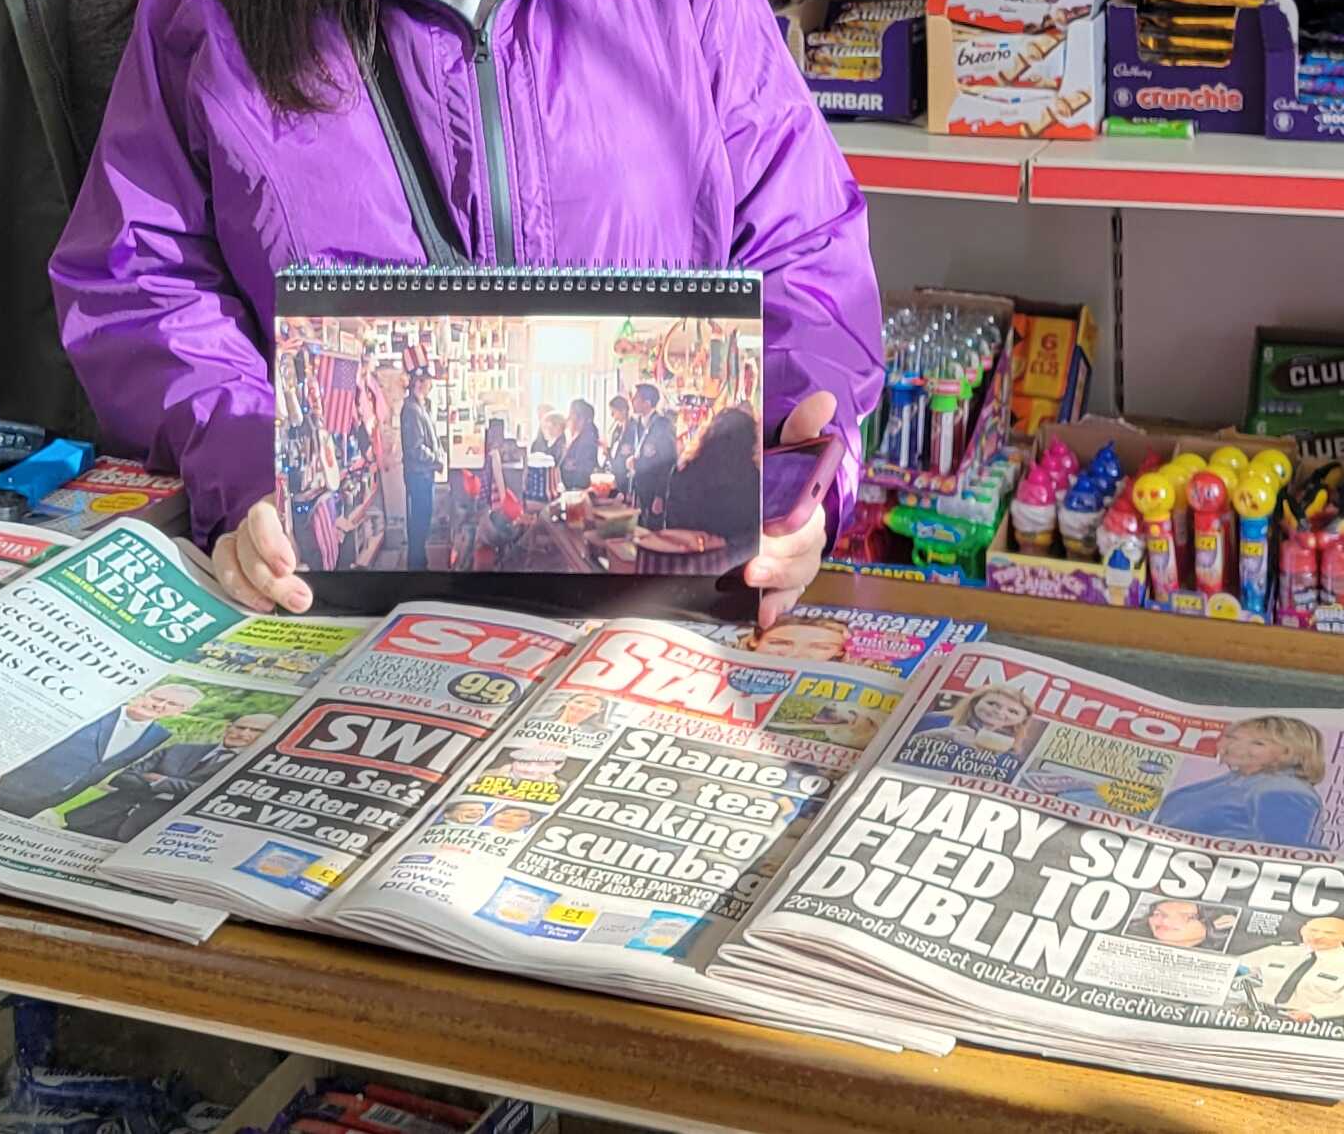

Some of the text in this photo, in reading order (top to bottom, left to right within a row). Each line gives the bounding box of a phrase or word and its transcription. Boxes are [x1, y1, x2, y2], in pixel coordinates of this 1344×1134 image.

[957, 46, 1012, 67] bueno
[1136, 83, 1243, 112] crunchie
[118, 531, 166, 571] THE
[66, 554, 194, 645] NEWS
[92, 541, 216, 634] IRISH
[12, 585, 151, 677] Criticism as
[667, 644, 736, 674] DAILY
[24, 665, 83, 702] LCC
[78, 649, 140, 689] DUP
[797, 676, 856, 702] FAT
[962, 656, 1222, 755] Mirror
[251, 752, 427, 807] Home Sec's
[616, 728, 789, 788] Shame
[226, 776, 365, 821] gig after
[593, 761, 781, 821] the tea
[861, 777, 1062, 863] MARY
[949, 775, 1338, 864] MURDER INVESTIGATION
[155, 834, 219, 855] lower
[203, 794, 369, 854] for VIP cop
[566, 794, 765, 860] making
[831, 817, 1132, 935] FLED TO
[800, 857, 1087, 981] DUBLIN
[784, 893, 1344, 1040] 26-year-old suspect quizzed by detectives in the Republic
